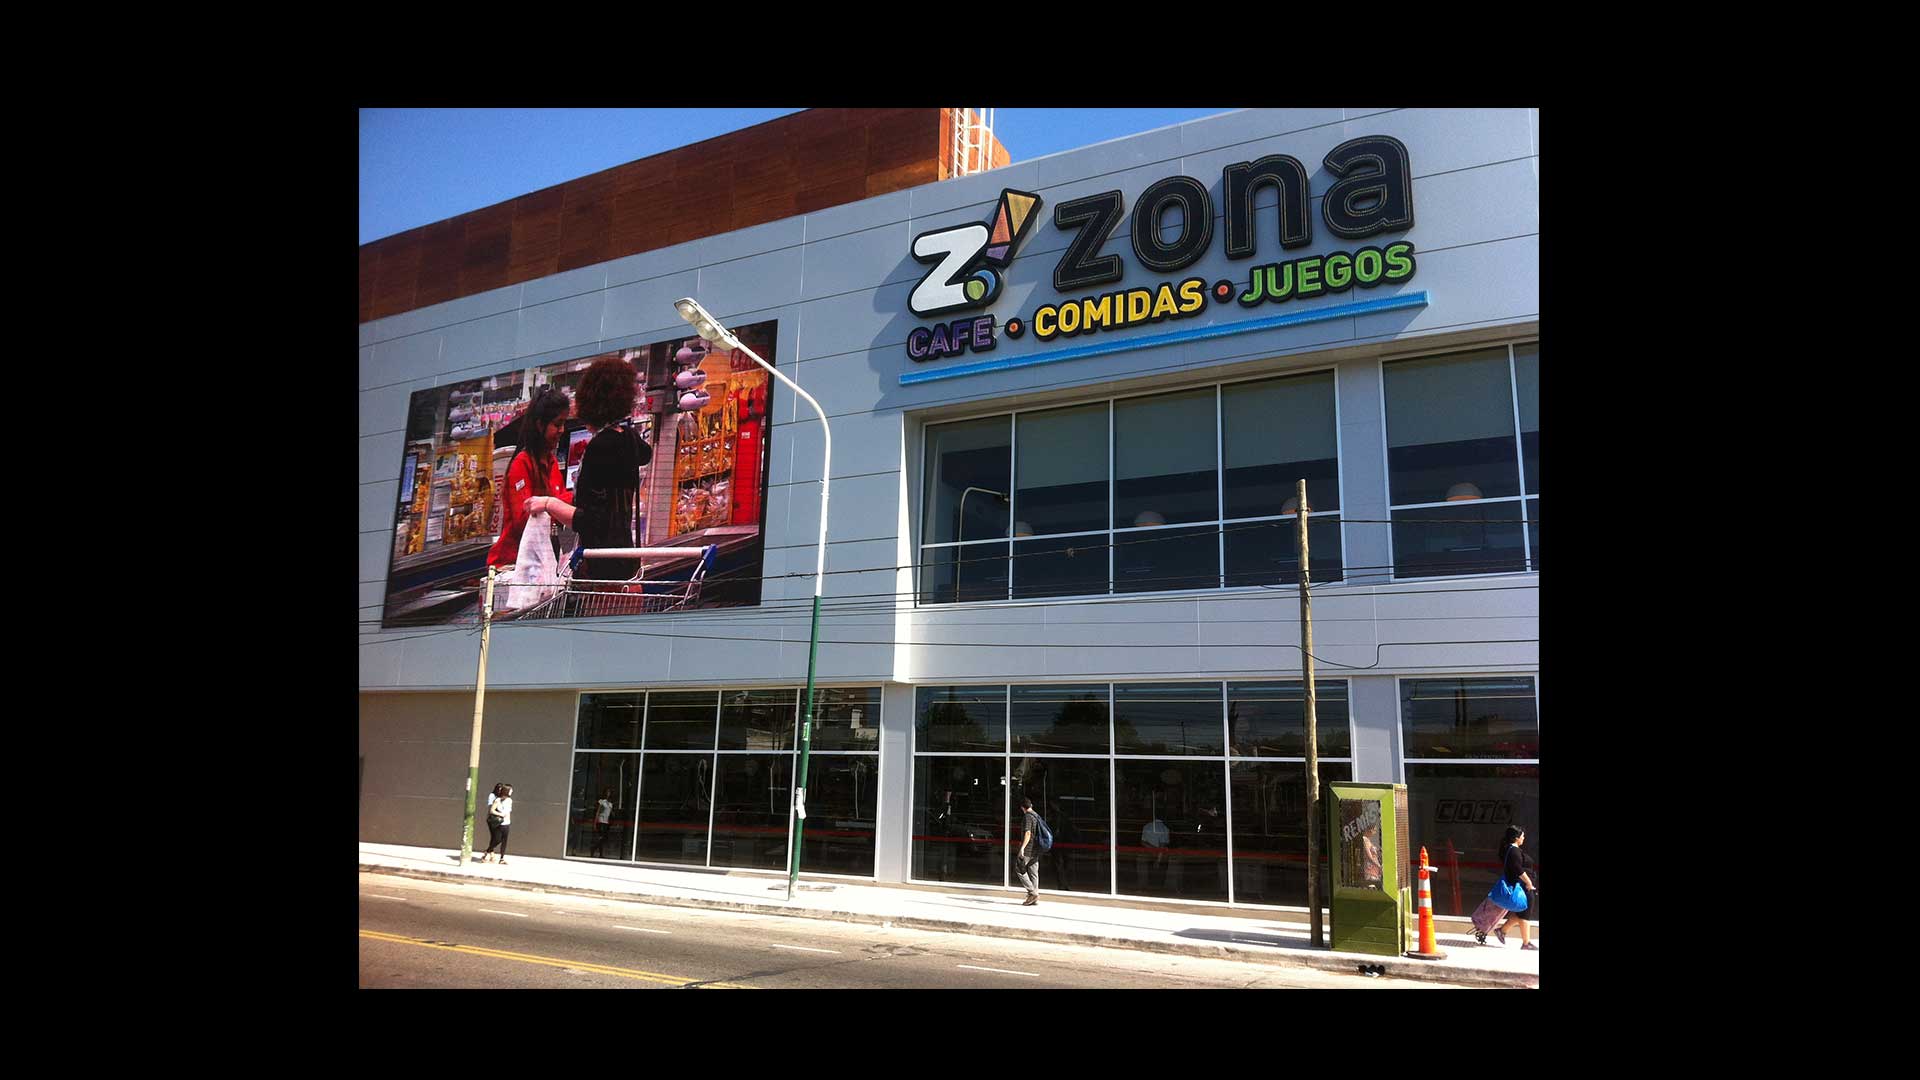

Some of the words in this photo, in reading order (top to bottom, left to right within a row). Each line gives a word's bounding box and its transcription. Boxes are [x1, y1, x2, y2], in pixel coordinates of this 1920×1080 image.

[908, 315, 994, 360] CAFE
[1034, 279, 1205, 338] COMIDAS
[1242, 245, 1414, 303] JUEGOS
